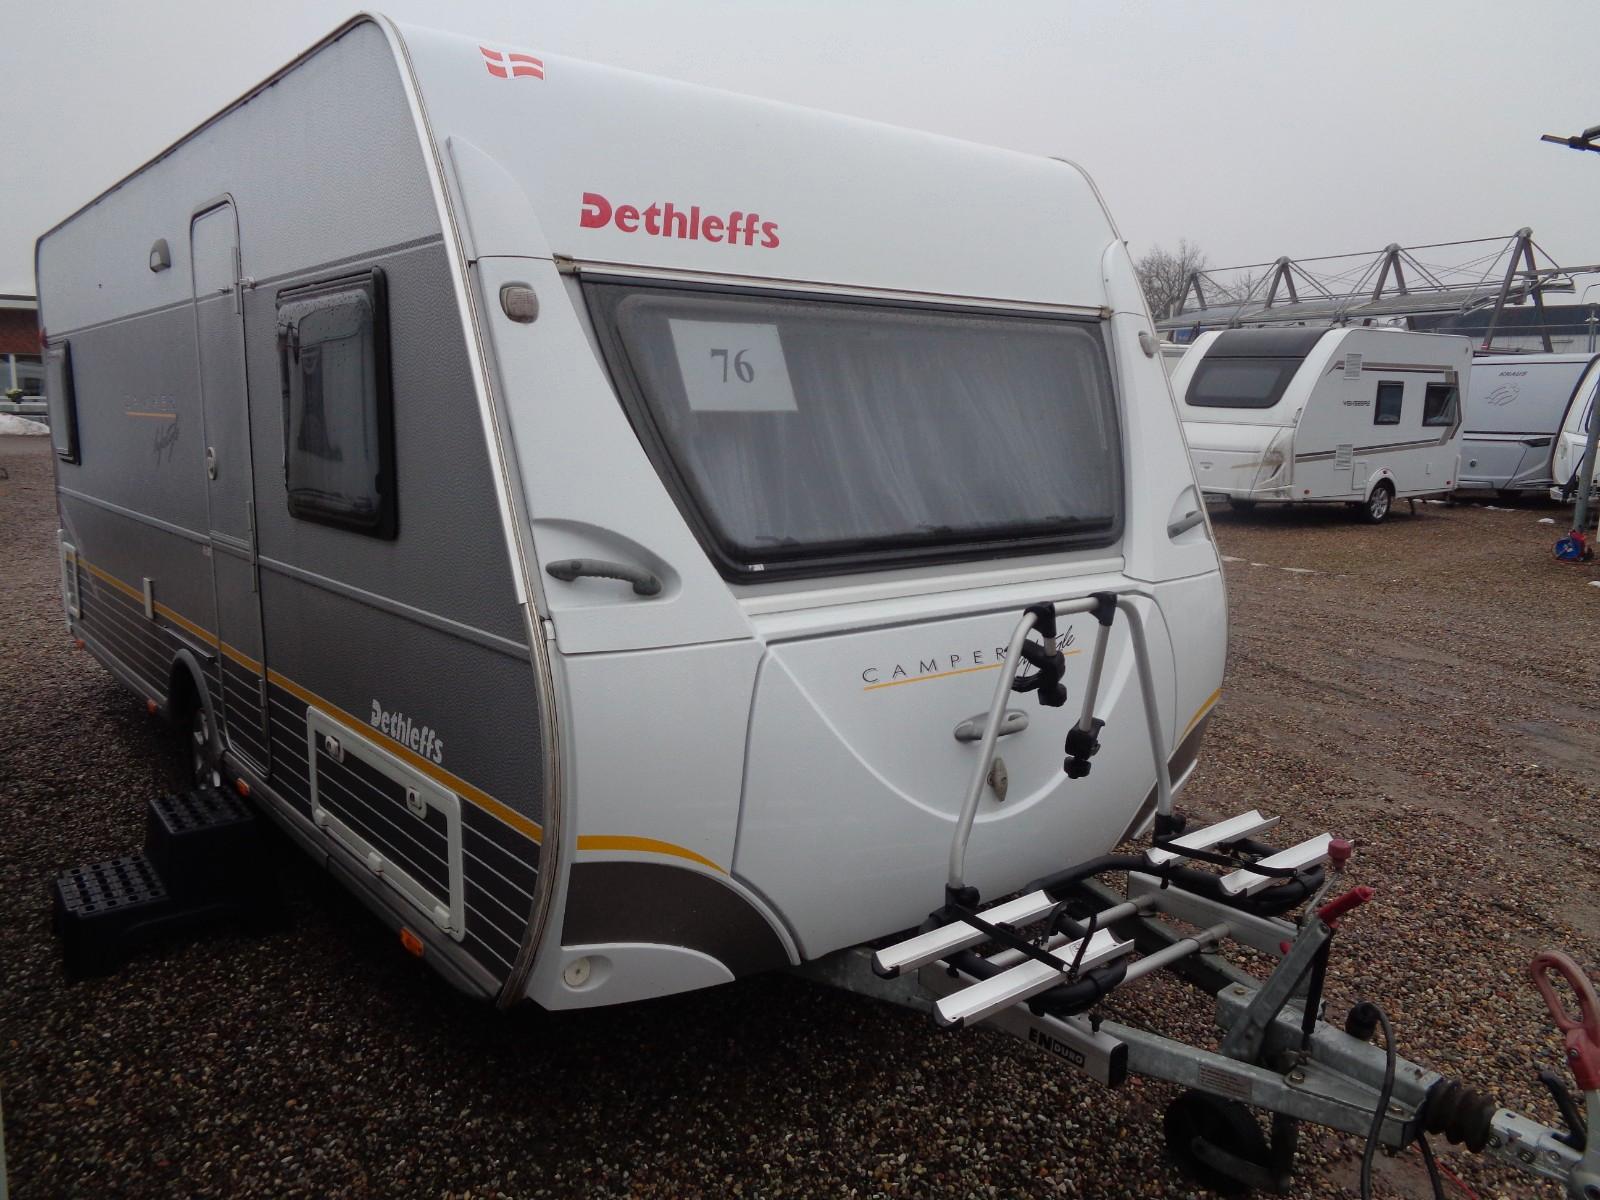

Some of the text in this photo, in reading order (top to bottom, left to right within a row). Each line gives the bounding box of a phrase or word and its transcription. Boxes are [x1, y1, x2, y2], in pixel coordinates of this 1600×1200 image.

[580, 192, 780, 248] Dethleffs
[711, 348, 754, 384] 76
[862, 647, 1008, 683] CAMPER
[370, 699, 443, 764] Dethleffs
